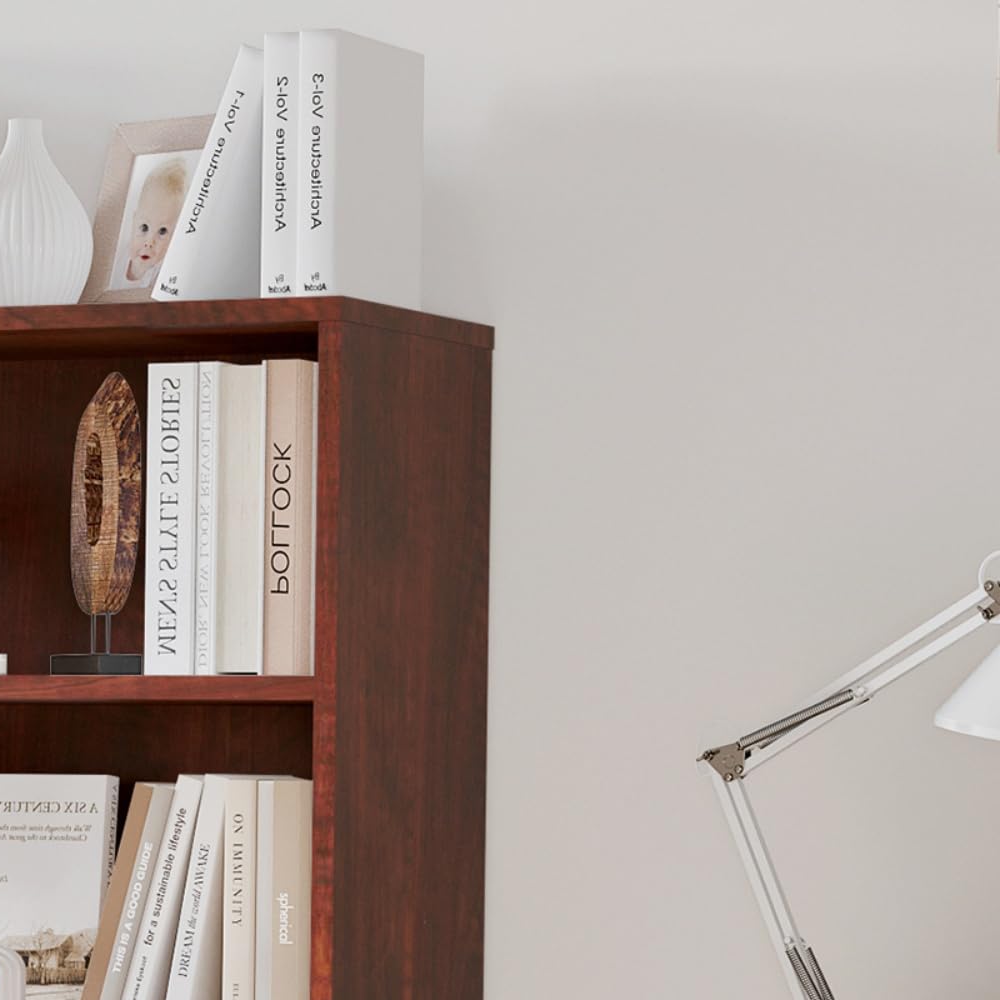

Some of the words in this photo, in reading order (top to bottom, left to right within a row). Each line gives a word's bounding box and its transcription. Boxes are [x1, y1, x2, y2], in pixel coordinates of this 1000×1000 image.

[168, 807, 187, 851] lifestyle
[233, 813, 243, 833] ON
[137, 841, 153, 880] GUIDE
[194, 843, 211, 887] AWAKE
[127, 882, 143, 919] GOOD
[153, 853, 175, 917] sustainable
[232, 843, 244, 927] IMMUNITY
[190, 890, 202, 914] world
[277, 892, 295, 944] spherical
[125, 921, 133, 931] A
[143, 930, 155, 946] for
[150, 919, 158, 927] a
[187, 915, 197, 929] the
[120, 933, 130, 944] IS
[178, 930, 195, 977] DREAM
[112, 946, 127, 973] THIS
